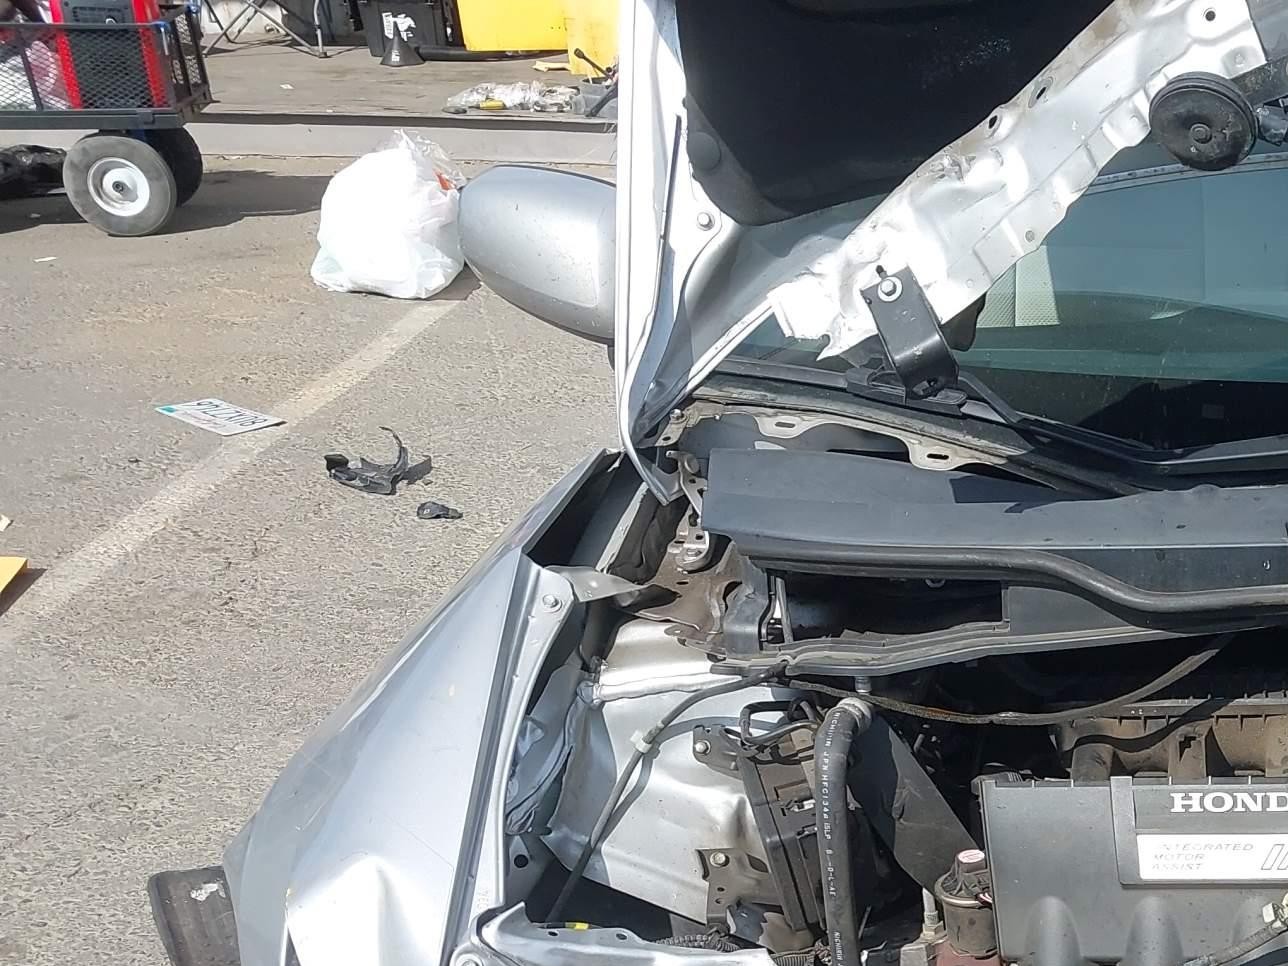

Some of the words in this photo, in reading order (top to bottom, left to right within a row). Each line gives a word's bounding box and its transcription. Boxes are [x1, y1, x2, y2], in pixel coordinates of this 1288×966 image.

[1158, 843, 1254, 851] NTEGRATED
[1153, 853, 1205, 861] MOTOR
[1152, 863, 1203, 871] ASSIST
